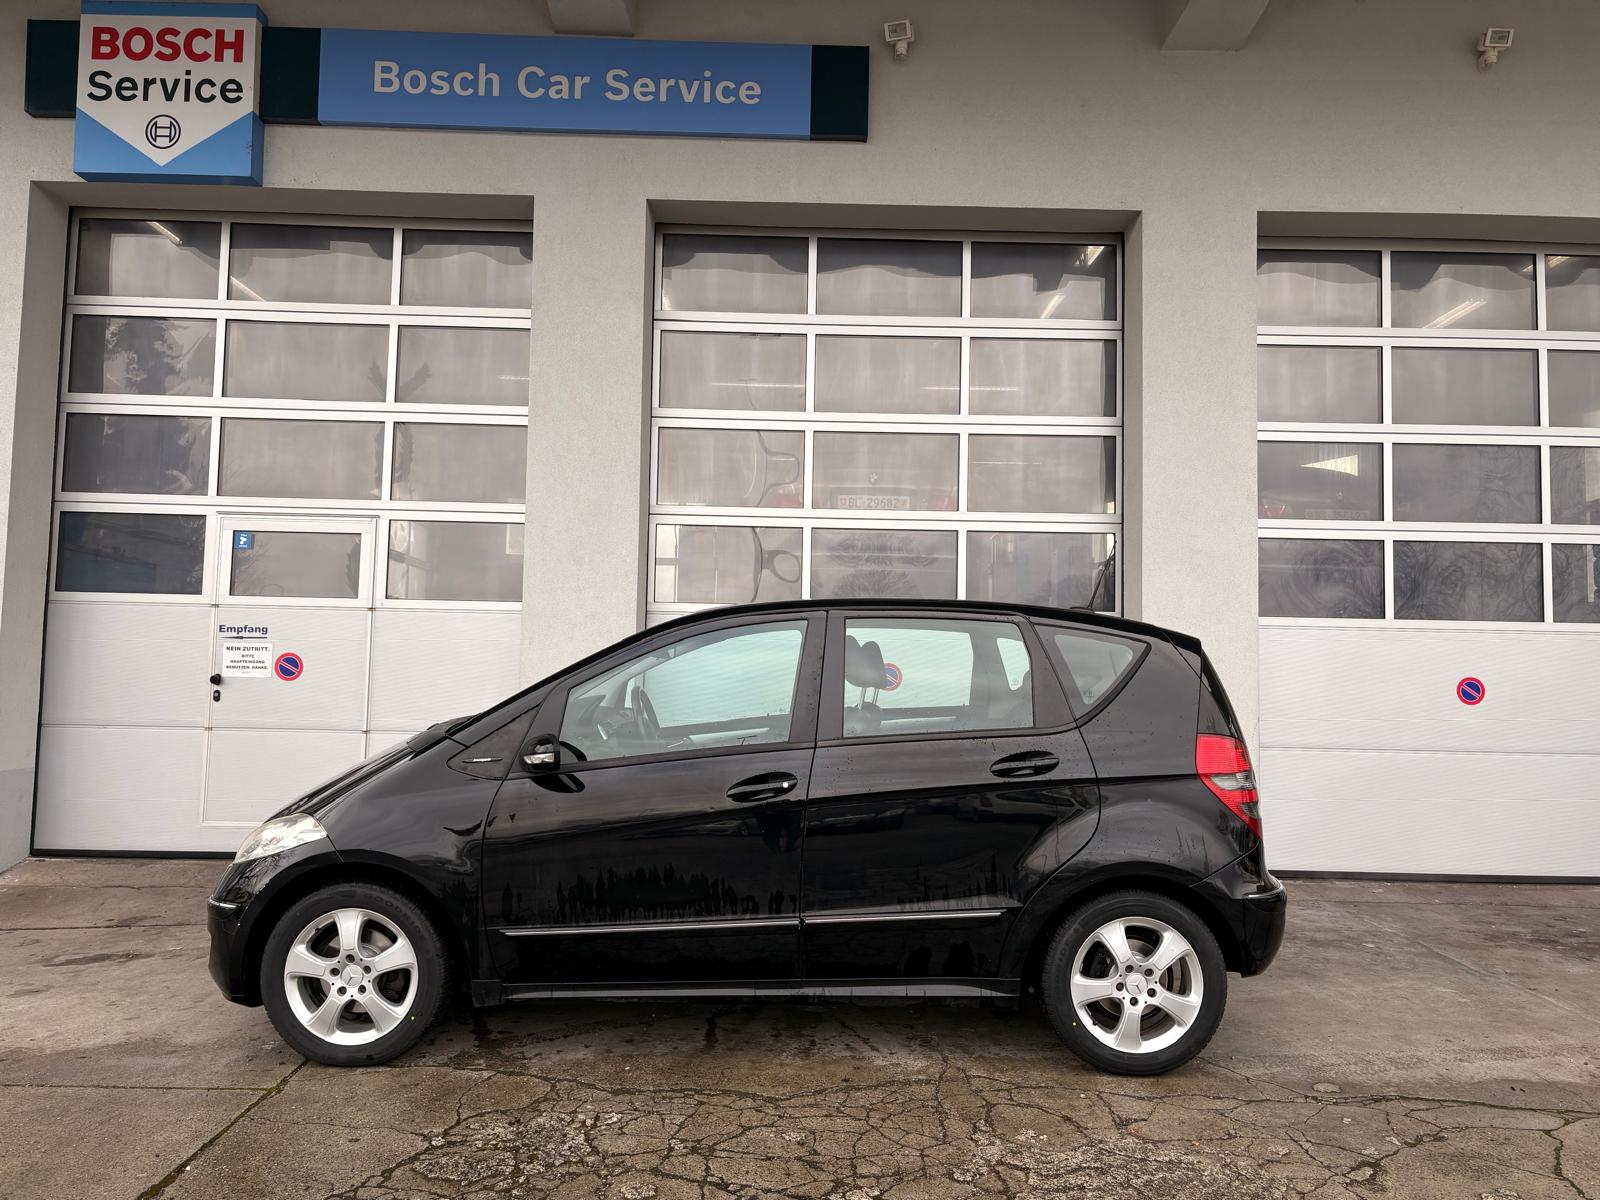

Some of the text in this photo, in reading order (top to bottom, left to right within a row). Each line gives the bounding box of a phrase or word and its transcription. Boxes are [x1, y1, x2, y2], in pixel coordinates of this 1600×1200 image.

[91, 26, 245, 63] BOSCH
[86, 69, 244, 104] Service
[373, 60, 762, 105] Bosch Car Service
[218, 624, 268, 635] Empfang
